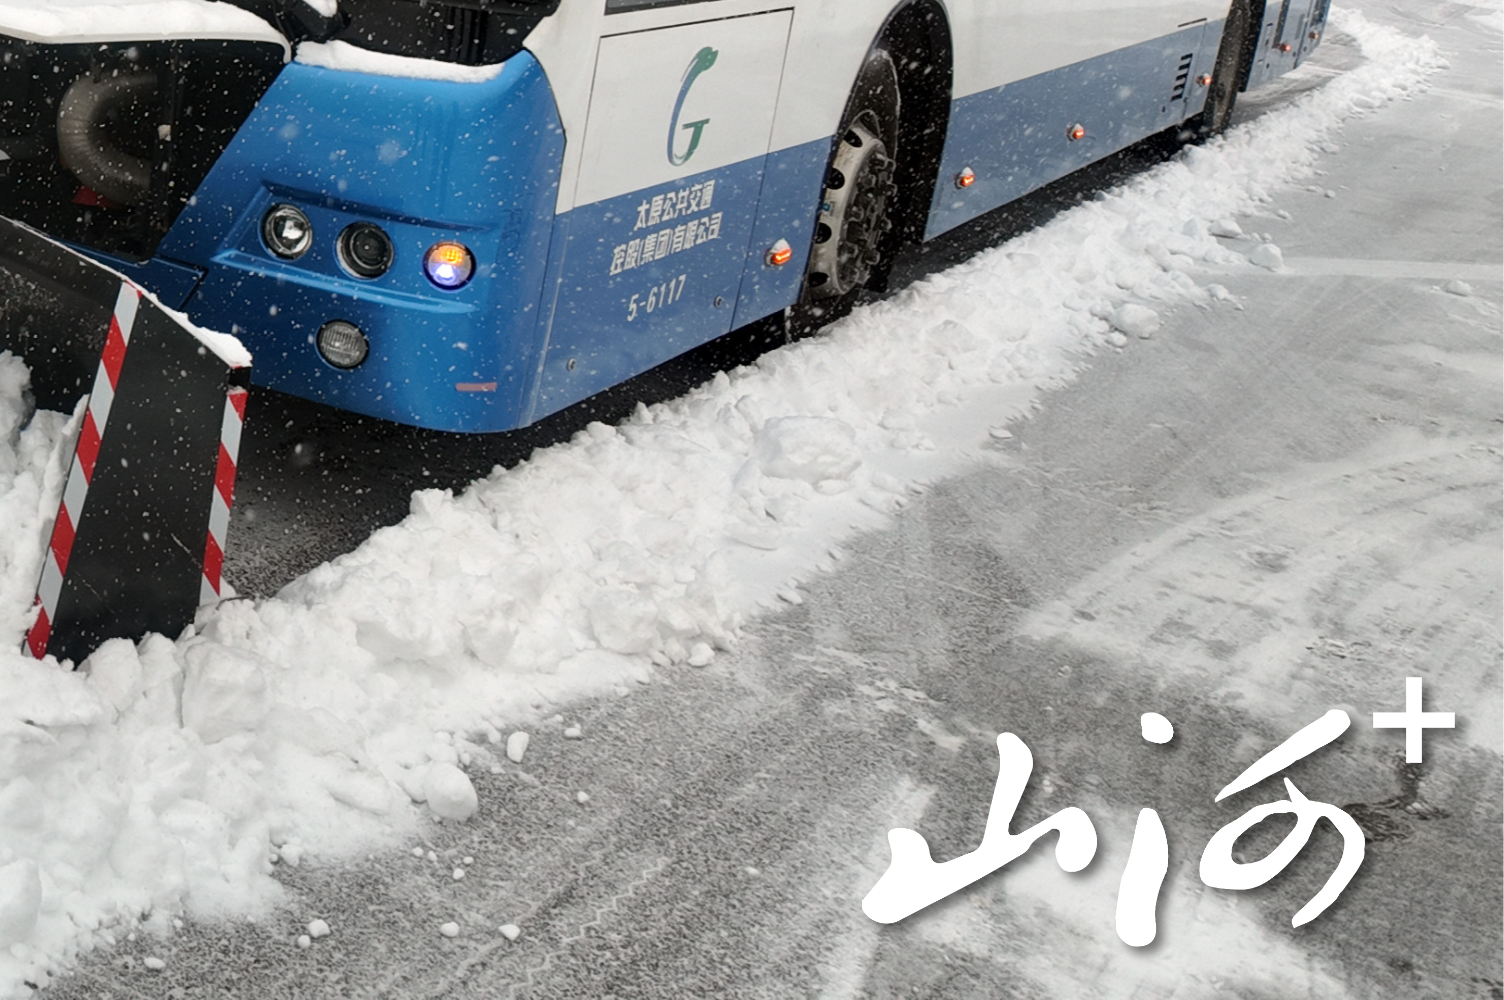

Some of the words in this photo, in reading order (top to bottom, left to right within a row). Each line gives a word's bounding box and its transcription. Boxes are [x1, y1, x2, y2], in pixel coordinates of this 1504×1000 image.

[633, 180, 715, 231] 太原公共交通
[627, 274, 687, 322] 5-6117
